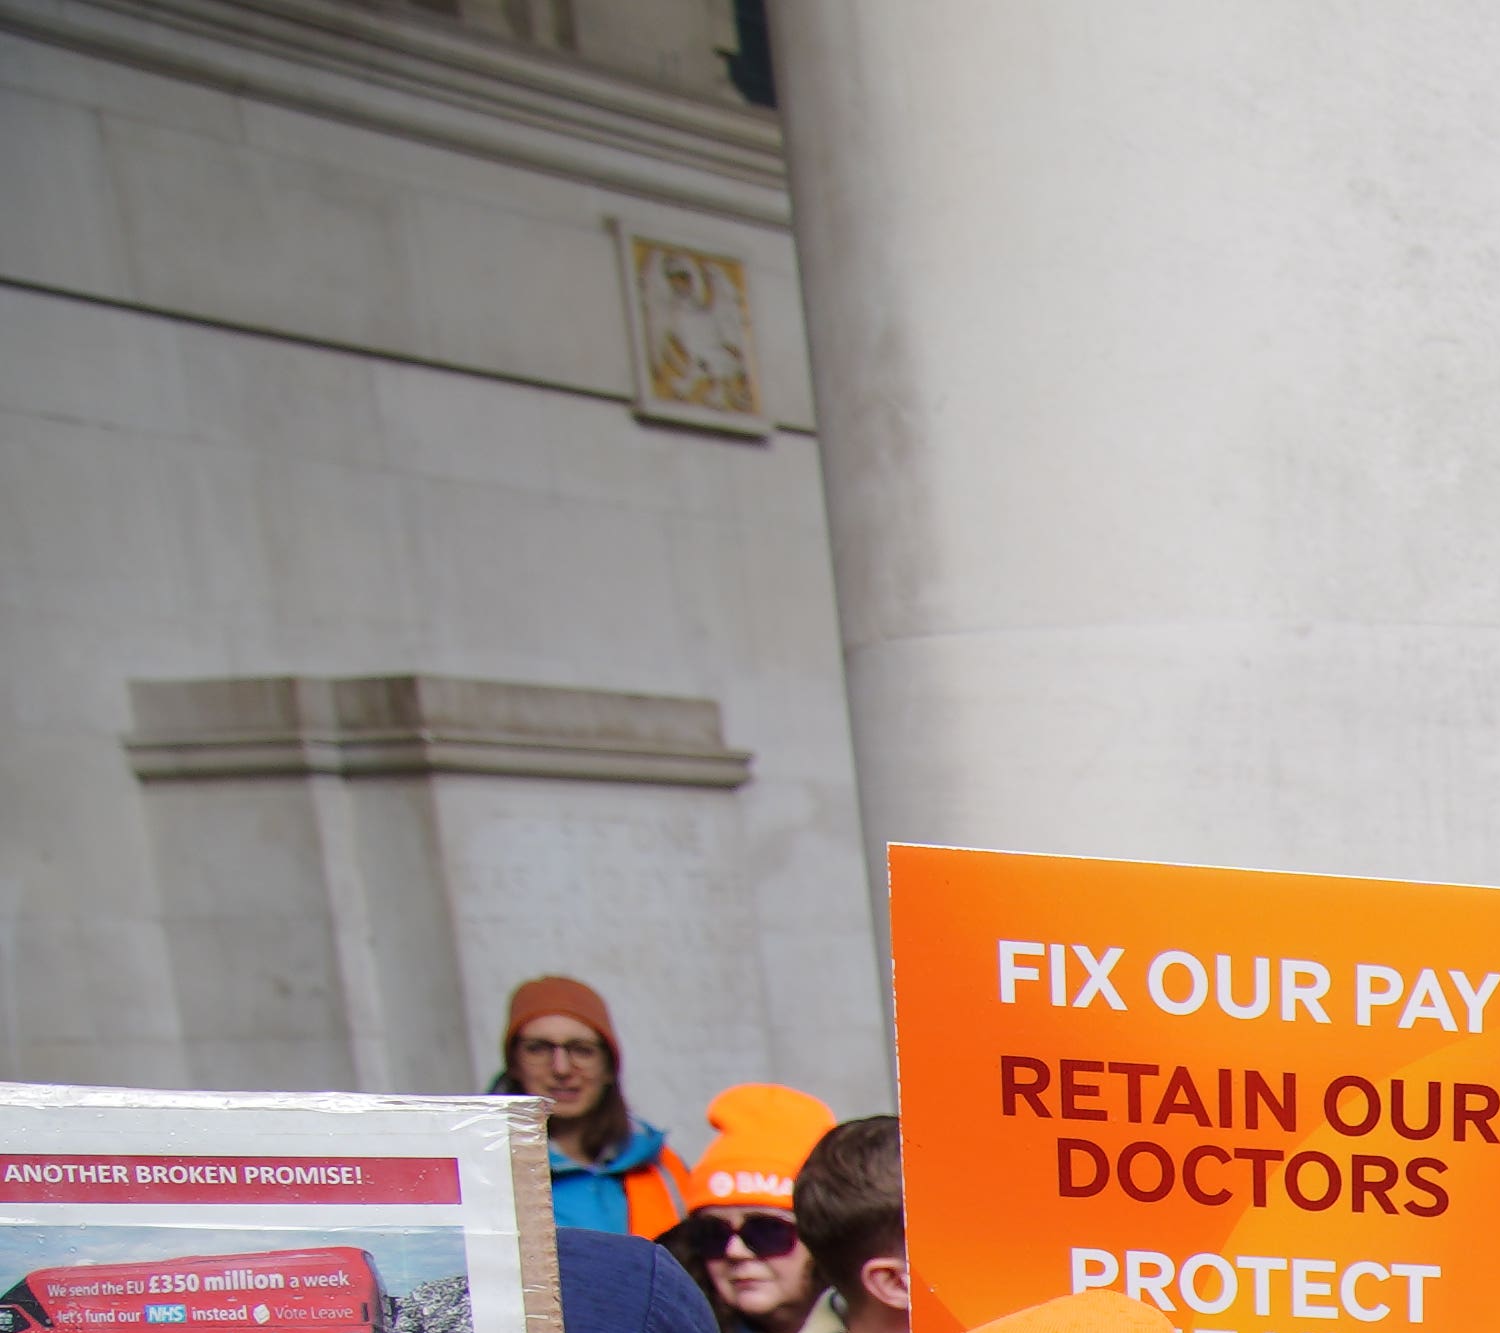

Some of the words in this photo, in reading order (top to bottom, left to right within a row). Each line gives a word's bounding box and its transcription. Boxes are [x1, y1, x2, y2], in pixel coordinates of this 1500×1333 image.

[997, 939, 1128, 1011] FIX
[1146, 949, 1331, 1024] OUR
[1000, 1055, 1297, 1133] RETAIN
[1323, 1075, 1500, 1144] OUR
[5, 1164, 129, 1184] ANOTHER
[136, 1165, 238, 1185] BROKEN
[244, 1166, 363, 1186] PROMISE!
[1056, 1137, 1450, 1218] DOCTORS
[48, 1284, 67, 1297] We
[69, 1282, 100, 1297] send
[102, 1281, 124, 1296] the
[127, 1280, 145, 1294] EU
[148, 1274, 200, 1294] £350
[205, 1271, 284, 1291] million
[289, 1277, 300, 1288] a
[304, 1271, 350, 1288] week
[85, 1308, 117, 1323] fund
[118, 1311, 141, 1323] our
[148, 1305, 185, 1323] NHS
[191, 1304, 248, 1321] instead
[275, 1305, 307, 1321] Vote
[312, 1305, 354, 1320] Leave
[1070, 1247, 1442, 1323] PROTECT
